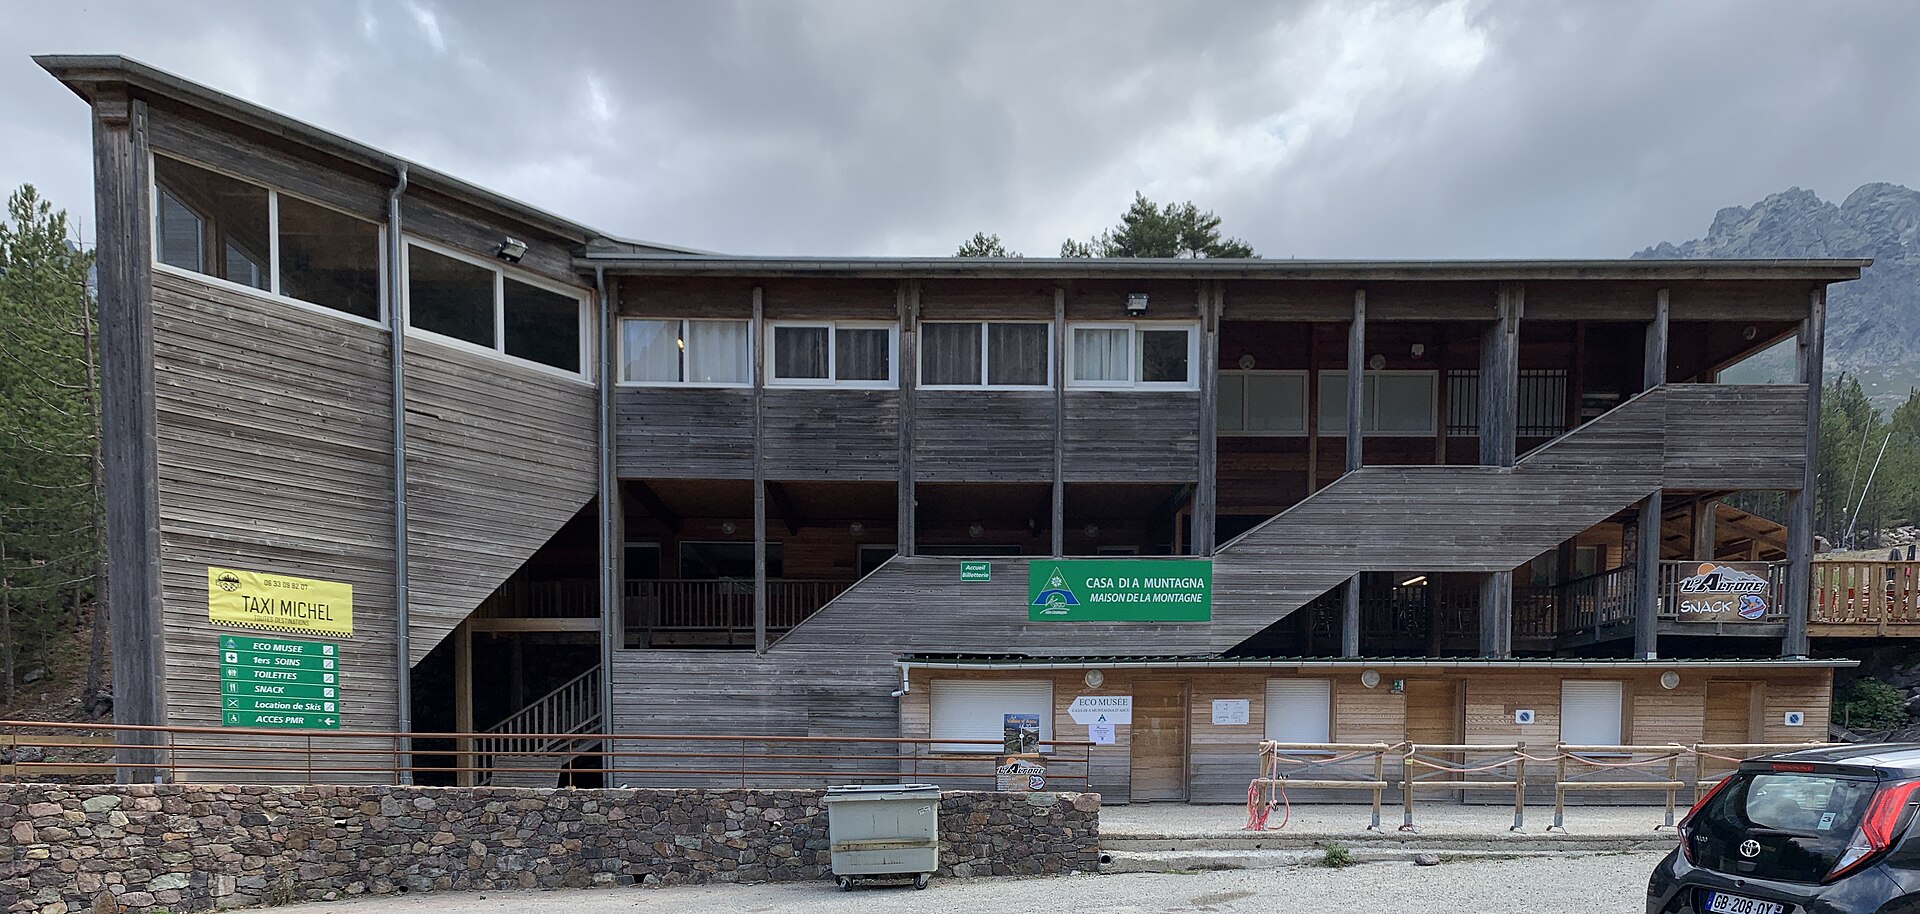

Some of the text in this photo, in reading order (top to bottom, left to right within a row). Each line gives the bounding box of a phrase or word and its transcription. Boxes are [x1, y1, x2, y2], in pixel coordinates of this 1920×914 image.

[1086, 578, 1205, 588] CASA DI A MUNTAGNA
[1090, 593, 1202, 602] MAISON DE LA MONTAGNE
[242, 595, 333, 621] TAXI MICHEL
[1680, 601, 1734, 614] SNACK
[274, 617, 310, 626] DESTINATIONS
[253, 643, 303, 653] ECO MUSEE
[274, 658, 301, 666] SOINS
[253, 670, 297, 680] TOILETTES
[254, 685, 284, 694] SNACK
[254, 701, 291, 709] Location
[1098, 697, 1128, 706] MUSÉE
